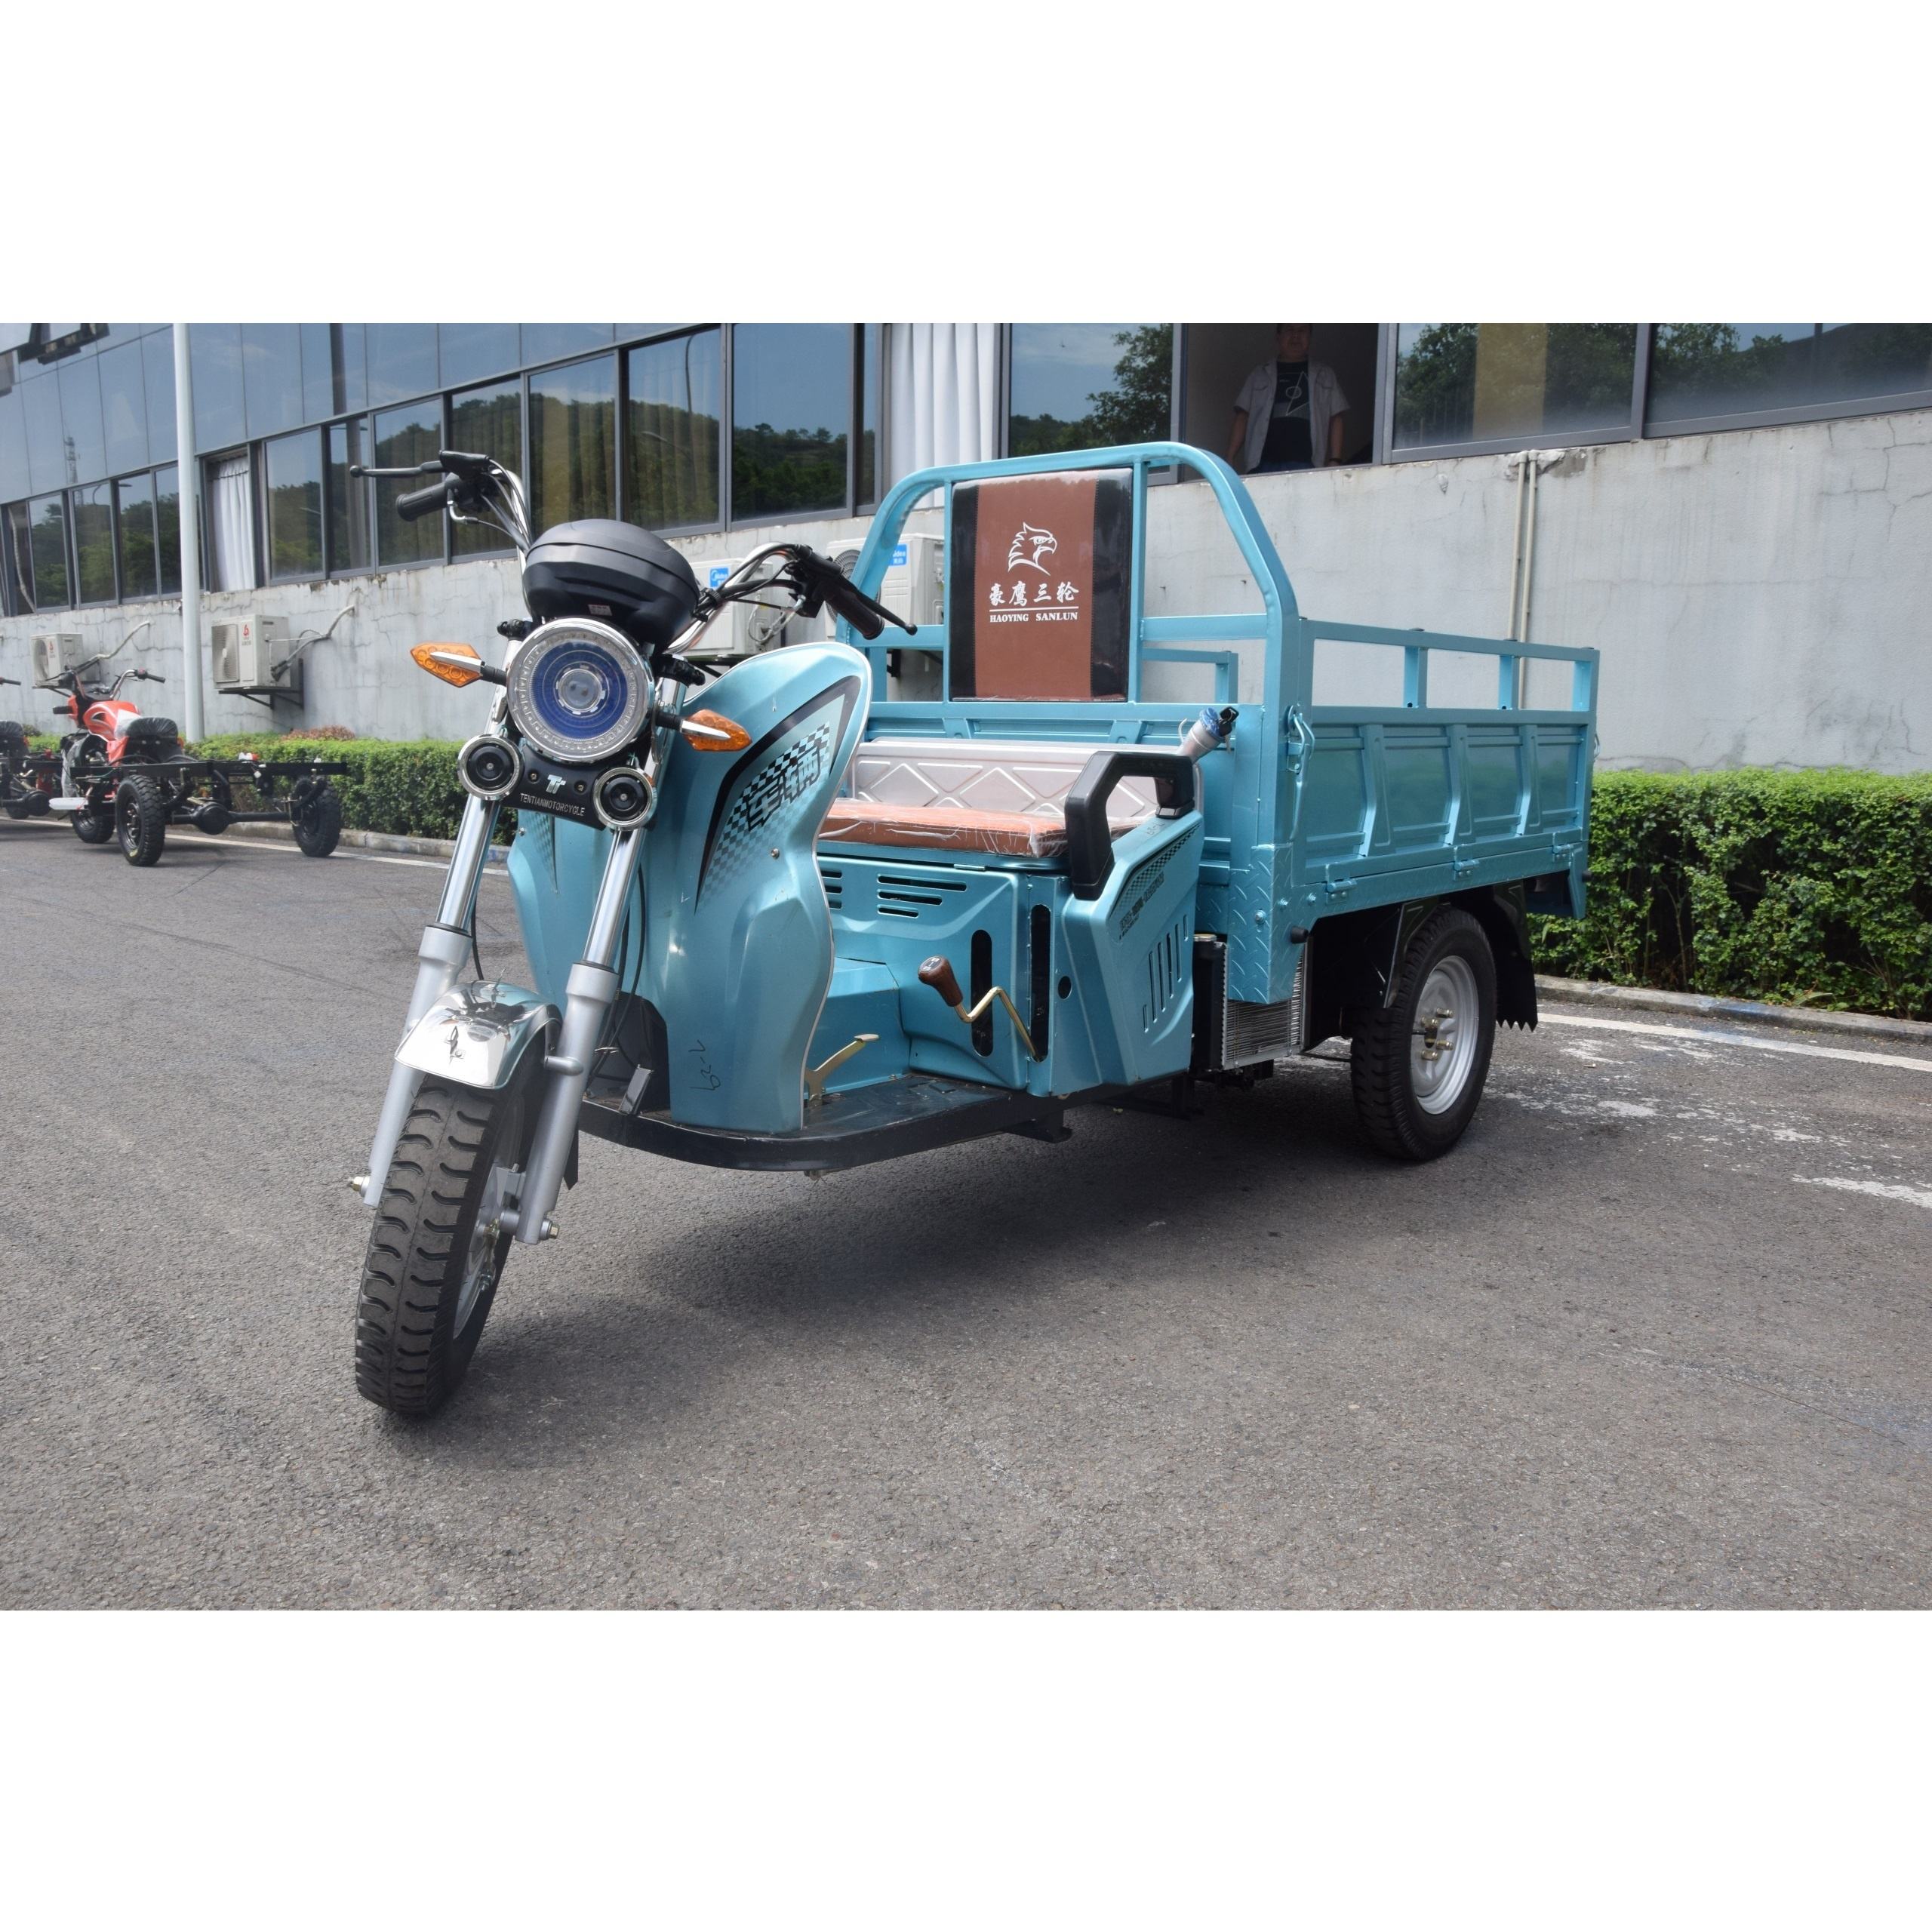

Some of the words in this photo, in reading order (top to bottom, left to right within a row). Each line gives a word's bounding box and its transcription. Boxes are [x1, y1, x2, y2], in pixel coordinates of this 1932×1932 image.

[989, 580, 1079, 606] 豪鹰三轮
[989, 614, 1029, 623] HAOYING
[1035, 612, 1078, 621] SANLUN
[519, 792, 586, 816] TENTIANMOTORCYCLE
